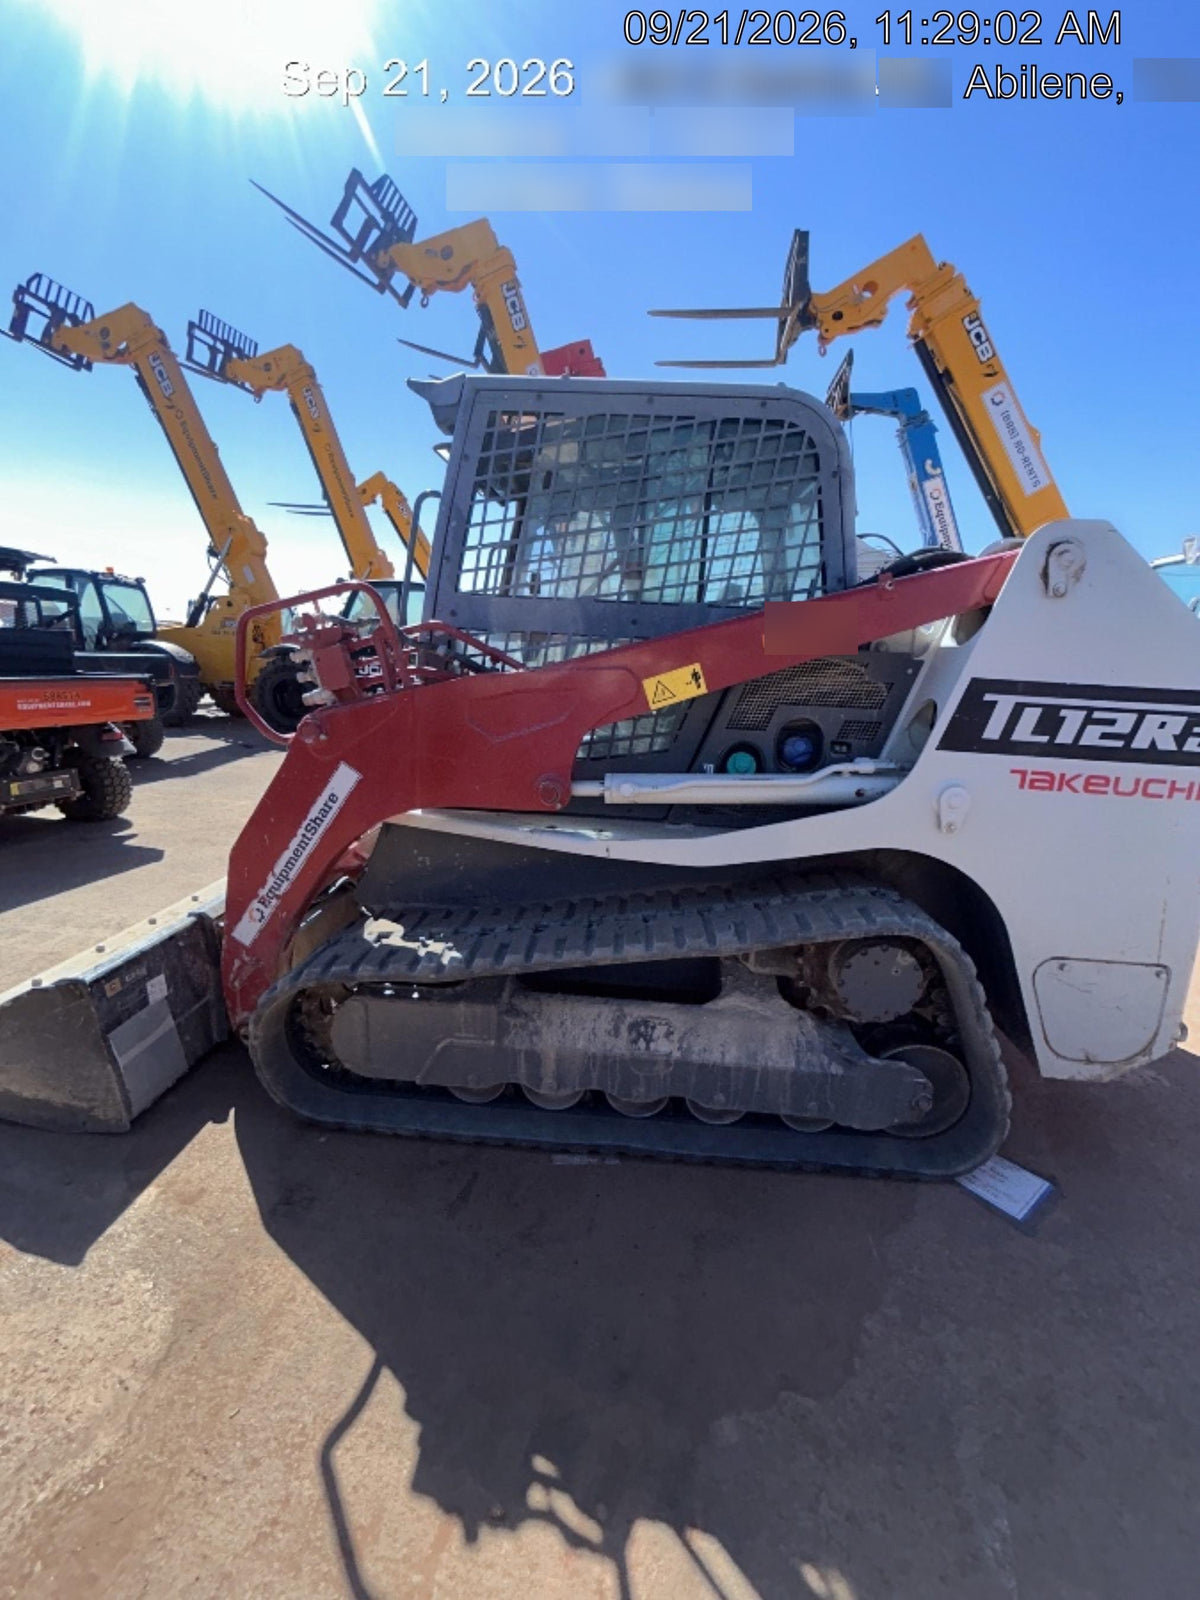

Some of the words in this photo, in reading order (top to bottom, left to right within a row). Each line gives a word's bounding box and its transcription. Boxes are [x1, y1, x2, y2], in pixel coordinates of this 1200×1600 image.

[502, 282, 527, 331] JCB
[962, 313, 993, 363] JCB
[149, 353, 175, 397] JCB
[257, 791, 339, 909] EquipmentShare
